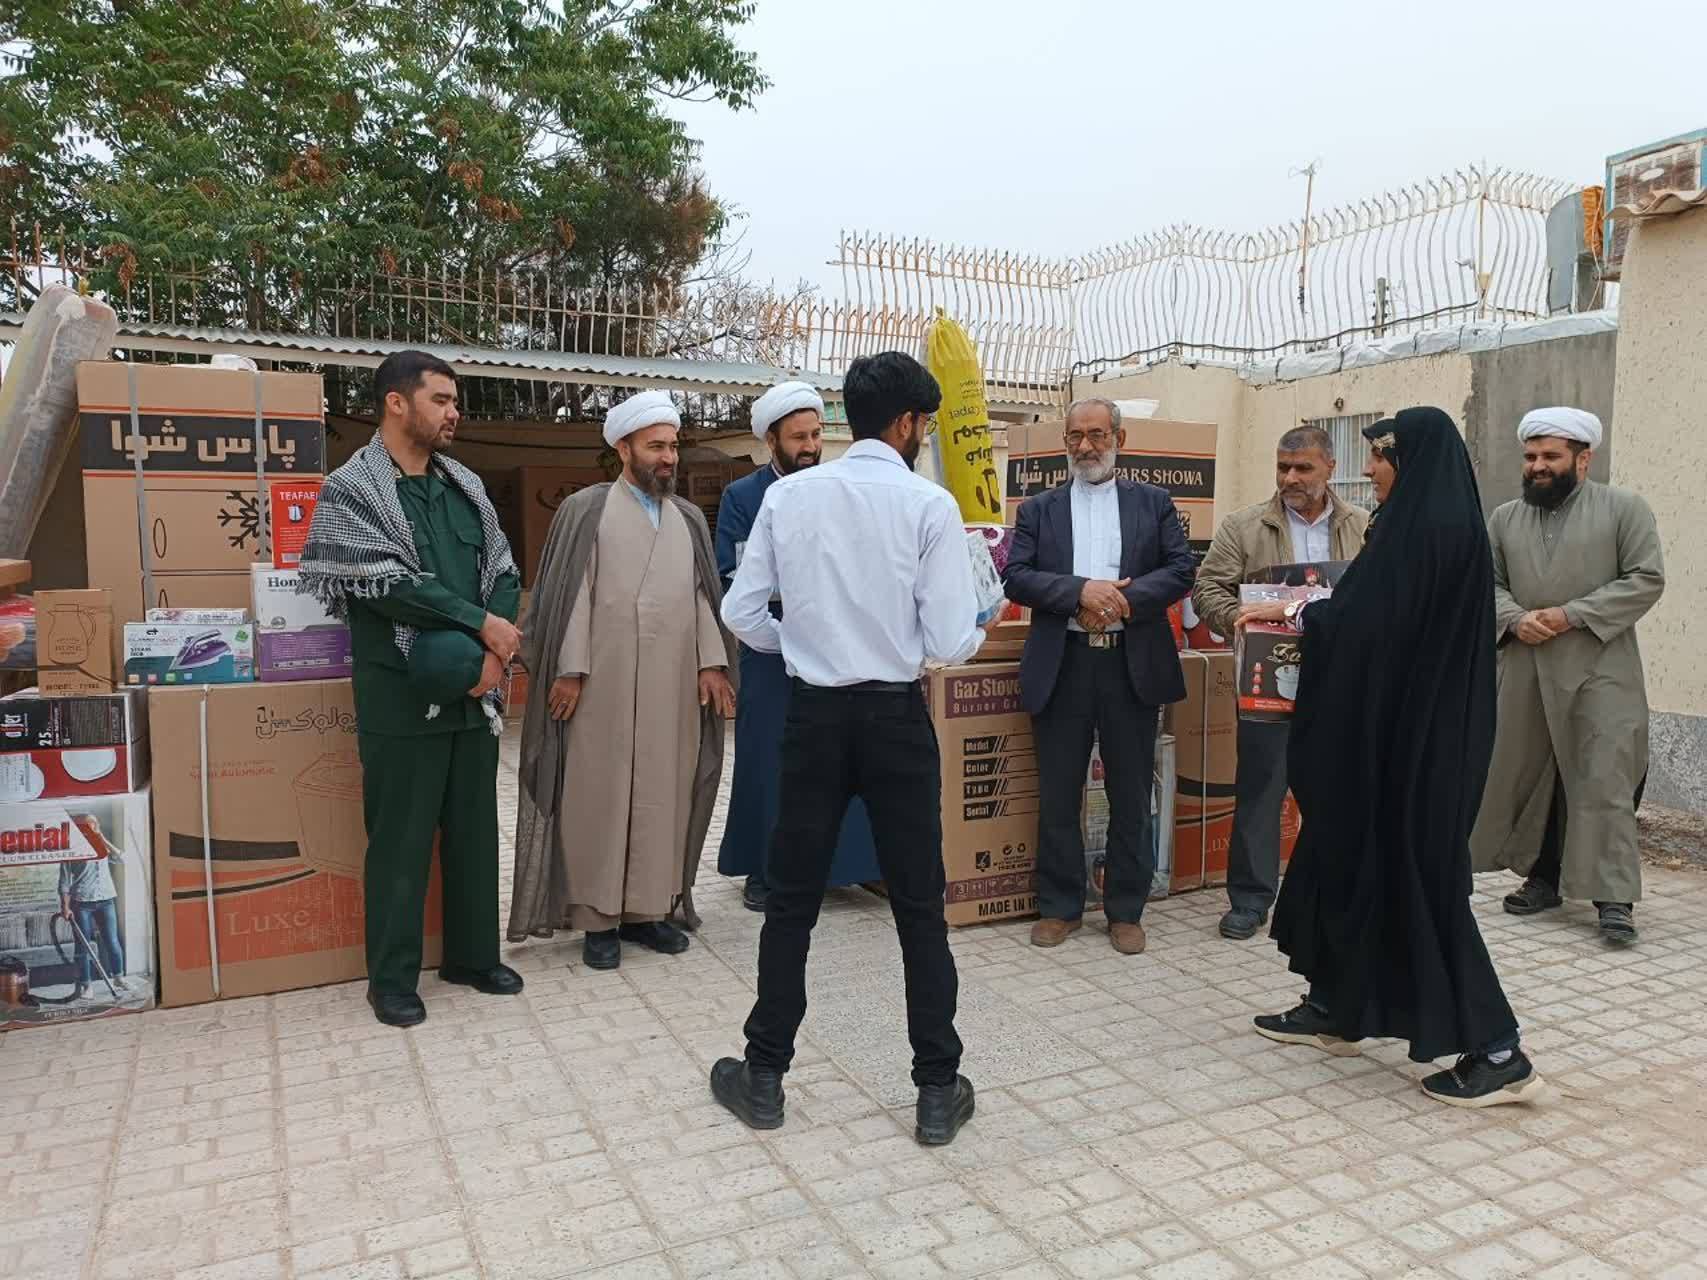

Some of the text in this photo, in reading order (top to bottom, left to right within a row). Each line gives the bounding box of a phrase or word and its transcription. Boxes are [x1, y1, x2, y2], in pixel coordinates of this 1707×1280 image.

[111, 418, 296, 470] پارس شوا
[1112, 467, 1204, 486] PARS SHOWA
[953, 679, 980, 700] Gaz
[953, 701, 996, 714] Burner
[38, 731, 52, 747] 25
[965, 739, 990, 752] Model
[965, 763, 990, 774] Color
[965, 784, 990, 796] Type
[965, 804, 990, 817] Serial
[978, 899, 1011, 917] MADE
[1014, 897, 1025, 912] IN
[225, 909, 312, 937] Luxe
